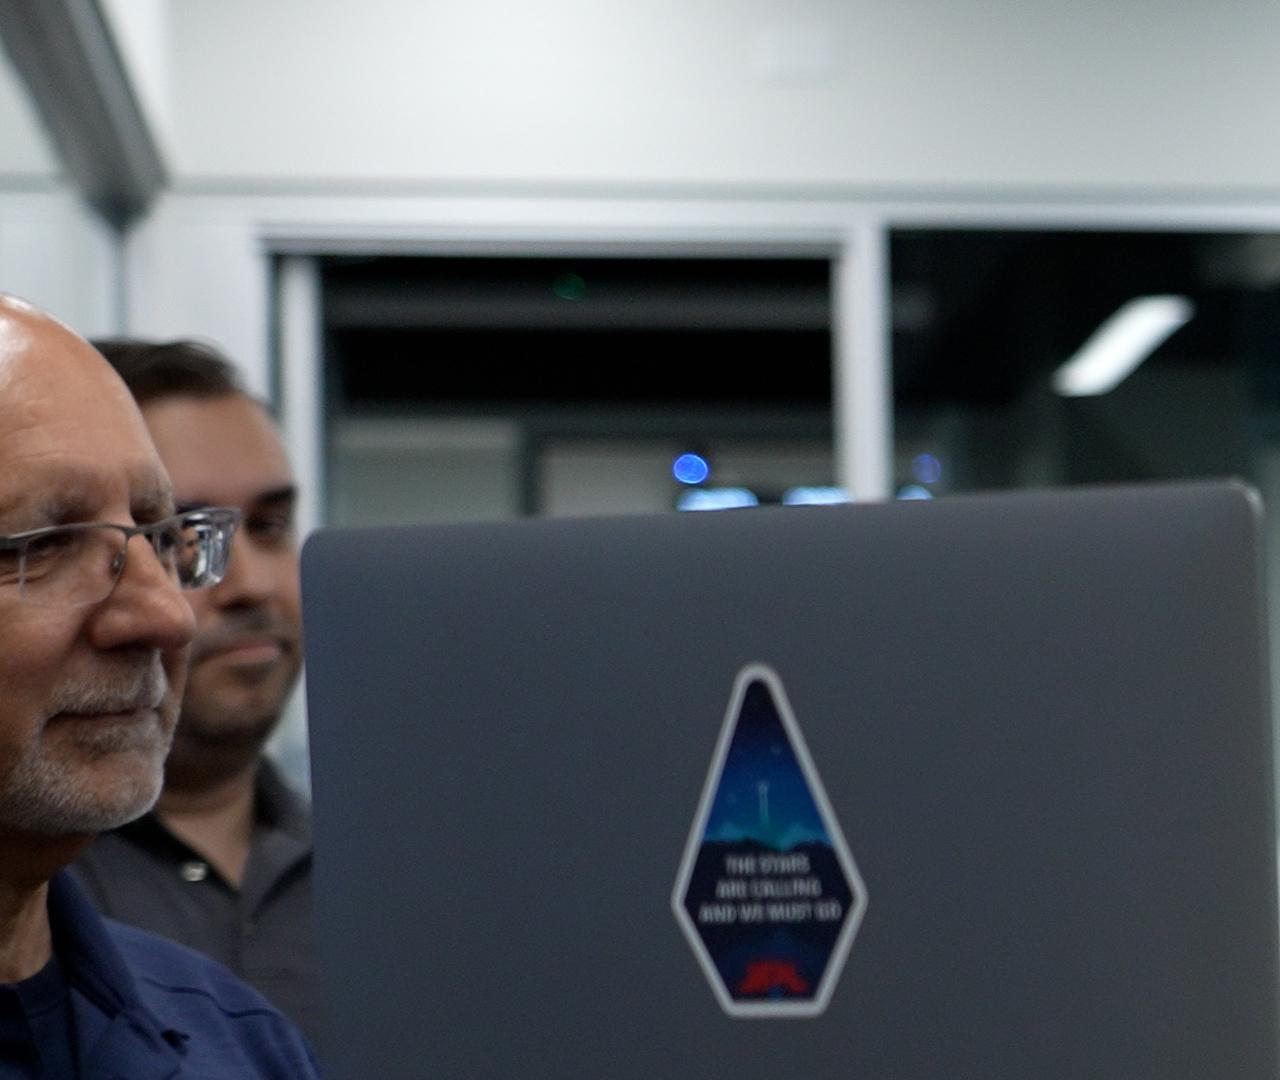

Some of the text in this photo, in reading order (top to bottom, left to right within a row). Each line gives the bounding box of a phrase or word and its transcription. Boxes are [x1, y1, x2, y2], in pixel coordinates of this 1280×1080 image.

[726, 853, 811, 875] THE STARS
[715, 876, 823, 898] ARE CALLING
[699, 902, 737, 923] AND
[766, 900, 813, 922] MUST
[814, 899, 843, 921] GO
